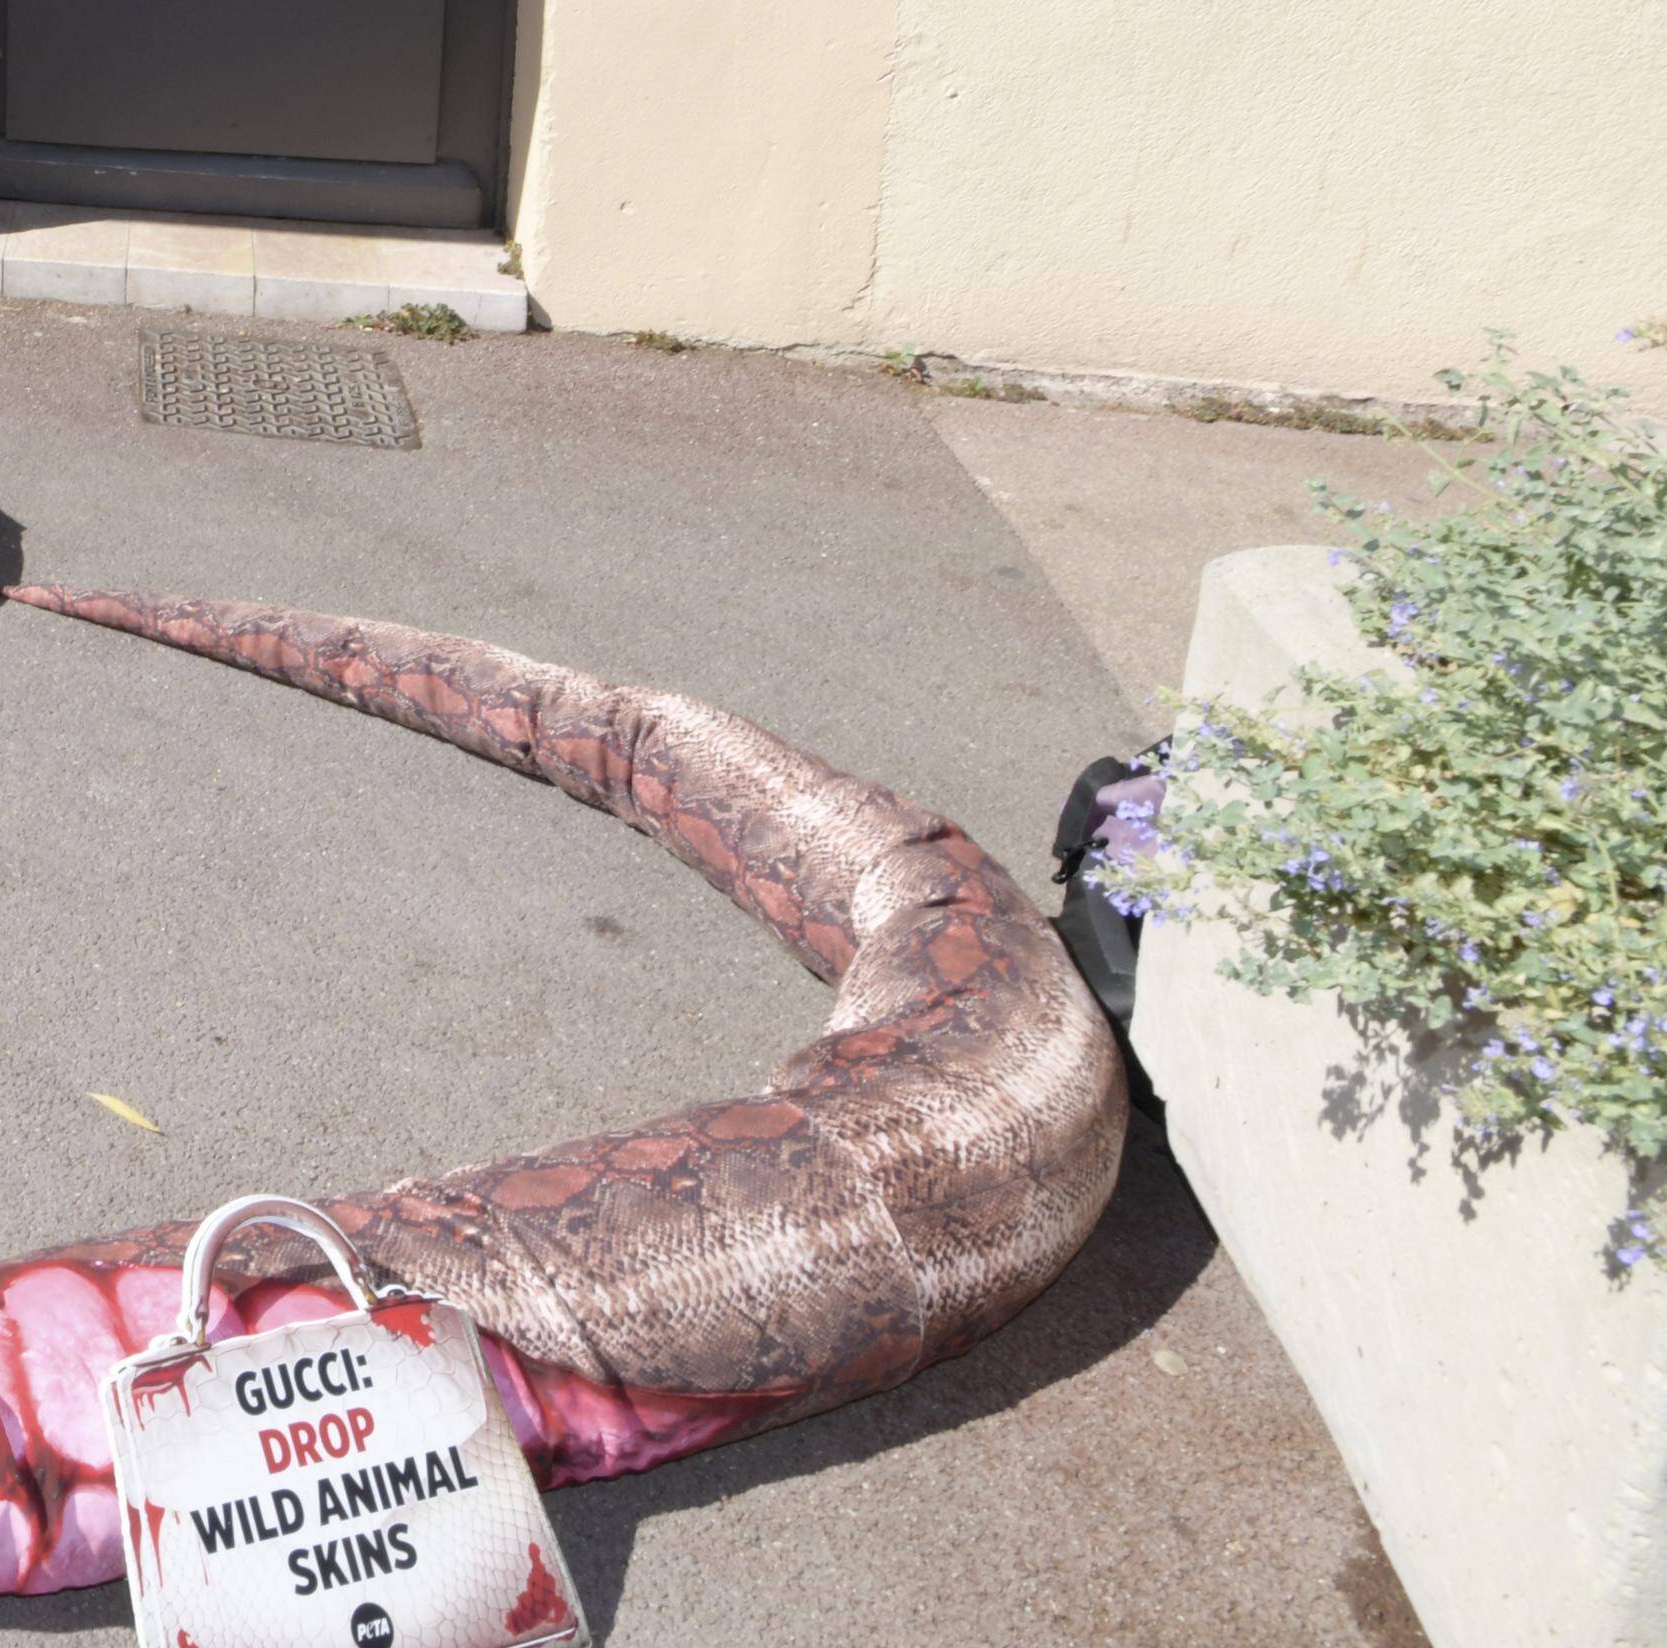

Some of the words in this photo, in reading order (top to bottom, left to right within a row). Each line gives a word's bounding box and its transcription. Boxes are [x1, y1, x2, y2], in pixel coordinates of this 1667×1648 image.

[235, 1349, 373, 1416] GUCCI:
[257, 1407, 376, 1475] DROP
[190, 1489, 305, 1555] WILD
[318, 1445, 478, 1529] ANIMAL
[287, 1523, 418, 1597] SKINS
